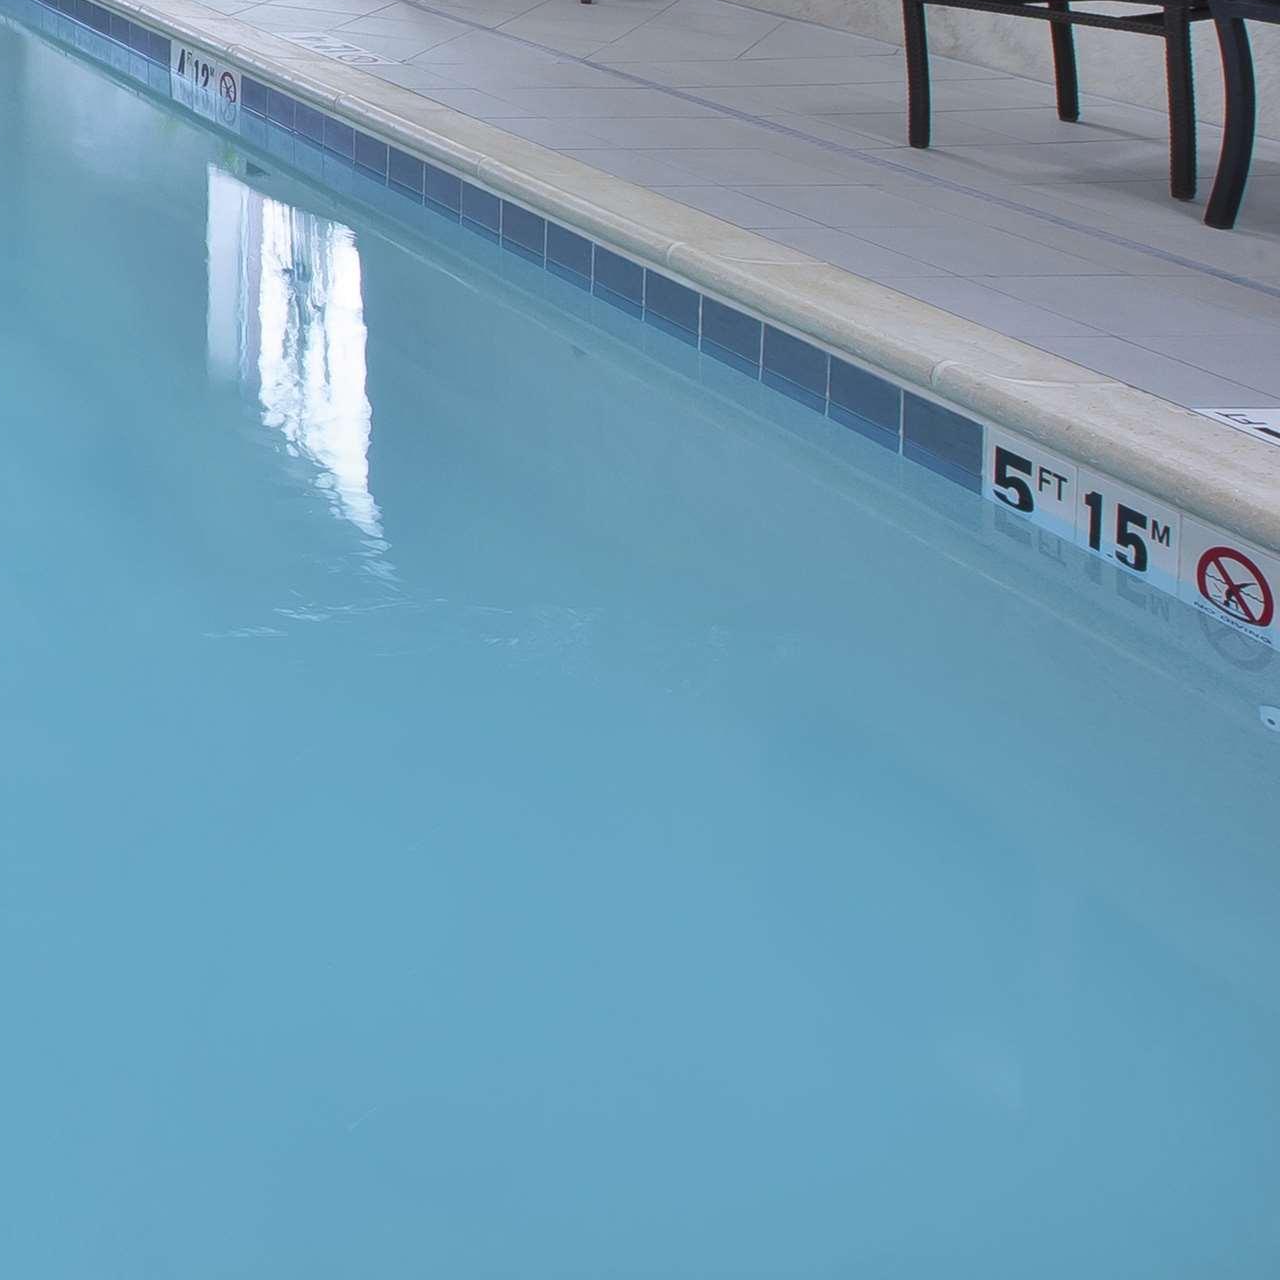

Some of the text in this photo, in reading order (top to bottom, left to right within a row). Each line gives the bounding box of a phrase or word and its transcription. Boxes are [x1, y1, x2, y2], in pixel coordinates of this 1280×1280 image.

[992, 445, 1034, 513] 5
[1037, 465, 1068, 502] FT
[1151, 519, 1171, 548] M
